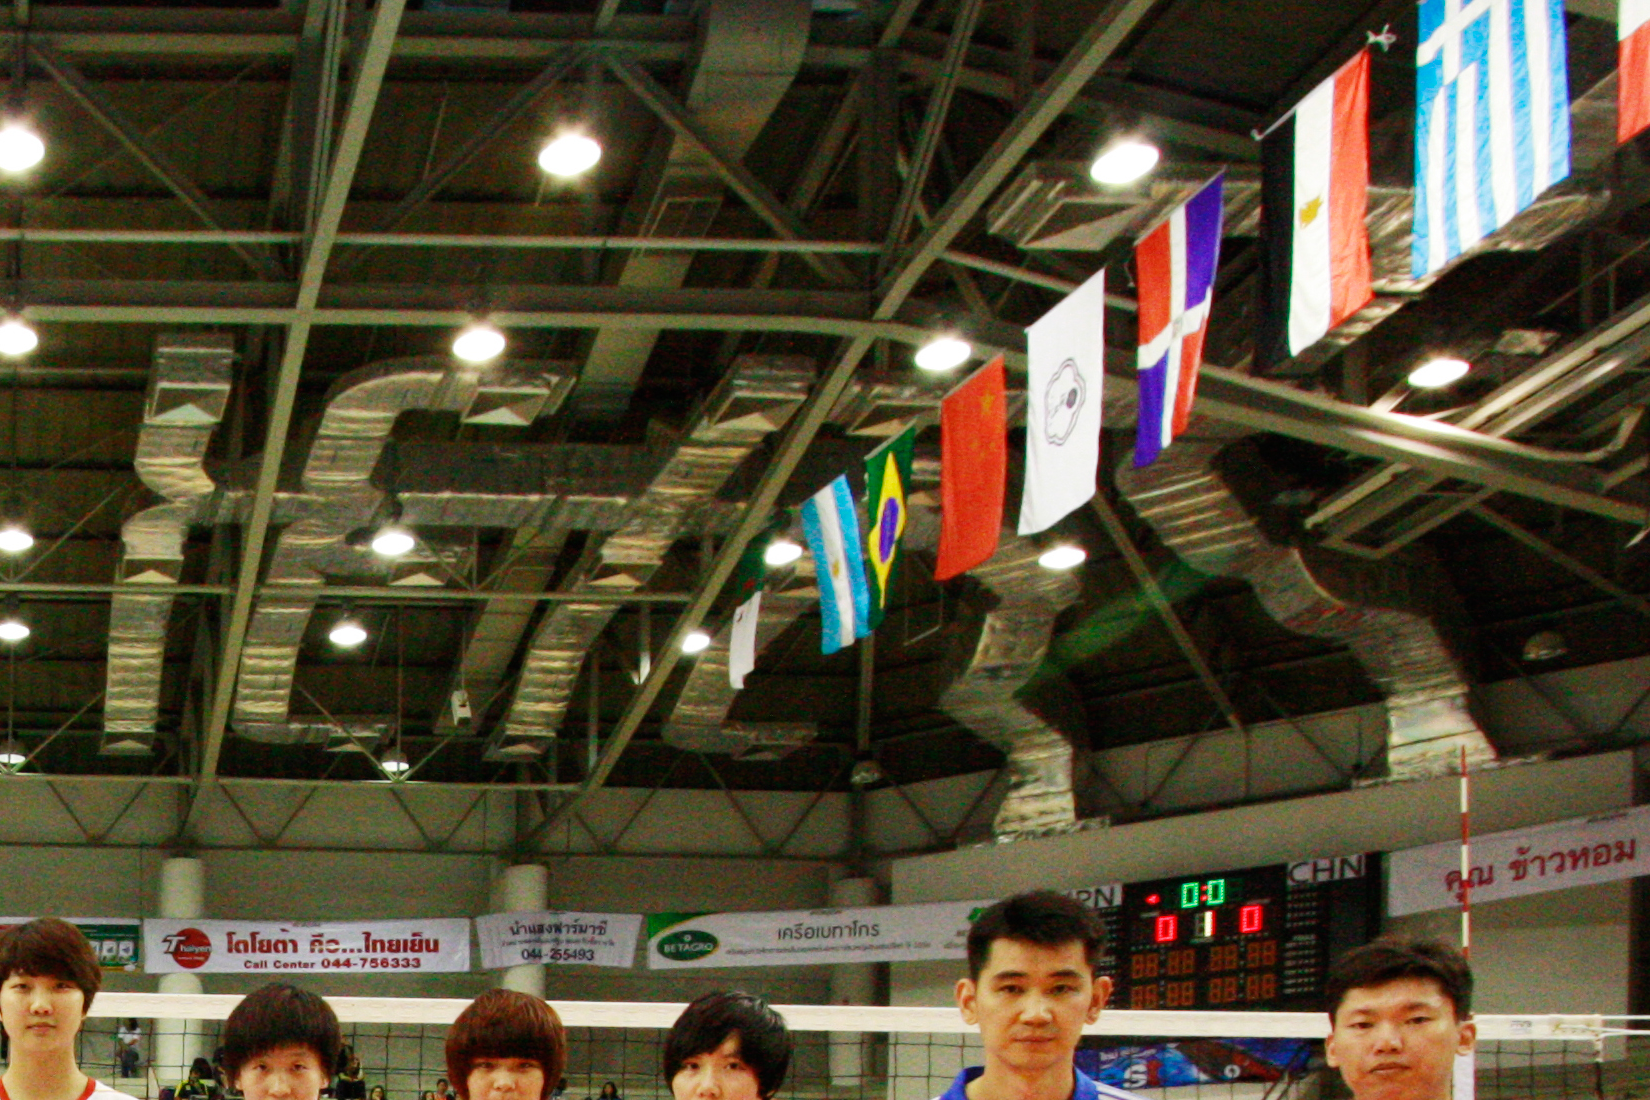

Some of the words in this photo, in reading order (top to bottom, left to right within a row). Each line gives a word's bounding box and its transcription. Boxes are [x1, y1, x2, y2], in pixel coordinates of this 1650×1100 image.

[1289, 854, 1363, 885] CHN
[778, 920, 880, 940] เครือเบทาโกร
[1155, 914, 1178, 942] 0
[1239, 904, 1263, 934] 0
[226, 928, 299, 954] โตโยต้า
[664, 942, 714, 954] BETAGRO
[244, 959, 268, 969] Call
[273, 959, 315, 969] Center
[321, 958, 422, 969] 044-756333
